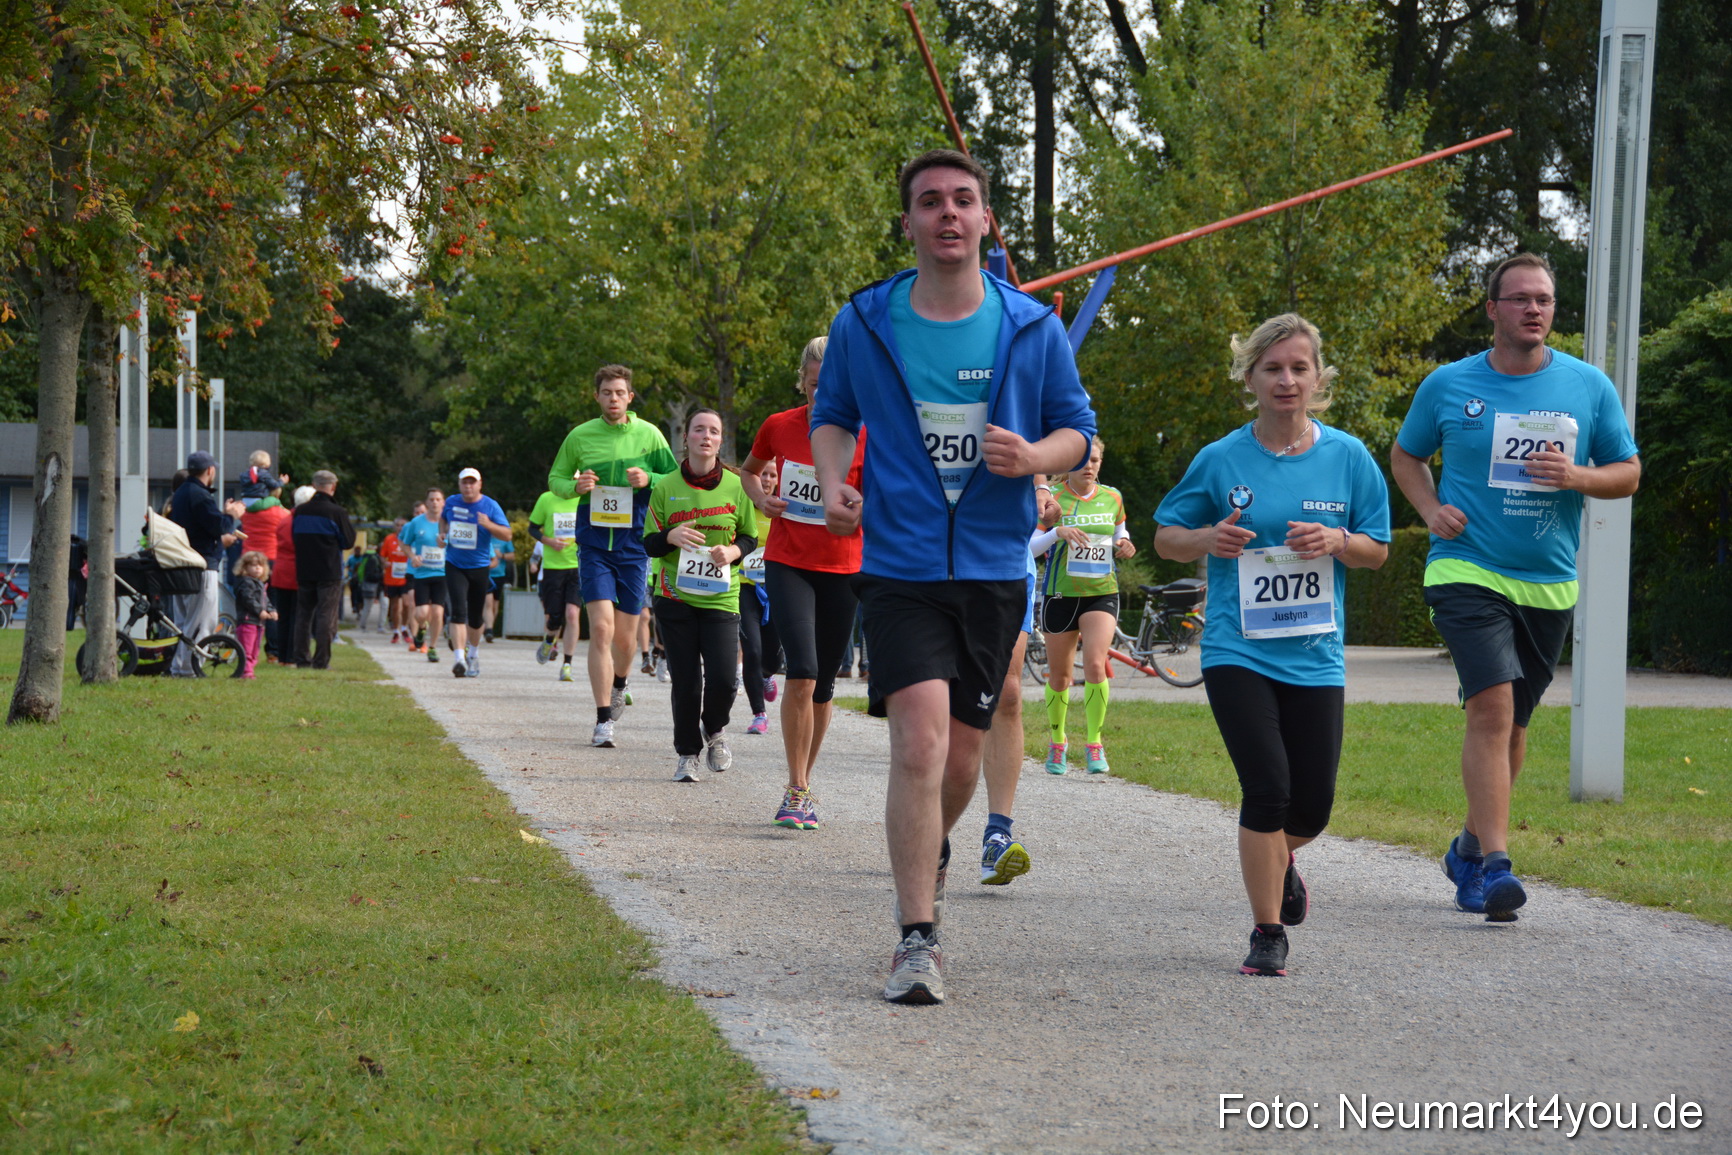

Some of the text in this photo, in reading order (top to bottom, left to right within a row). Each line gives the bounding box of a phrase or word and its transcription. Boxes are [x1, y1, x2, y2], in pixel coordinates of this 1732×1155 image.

[958, 369, 994, 380] BOC
[931, 413, 965, 422] BOCK
[922, 433, 977, 462] 250
[939, 474, 961, 483] reas
[788, 480, 821, 502] 240
[603, 498, 617, 511] 83
[1303, 500, 1345, 512] BOCK
[1503, 497, 1553, 507] Neumarkter
[801, 506, 816, 514] Julia
[1503, 507, 1544, 518] Stadtlauf
[1063, 513, 1114, 527] BOCK
[453, 529, 473, 539] 2398
[1075, 546, 1105, 561] 2782
[1273, 554, 1303, 562] BOC
[749, 558, 764, 568] 22
[685, 559, 723, 579] 2128
[1254, 571, 1321, 603] 2078
[1272, 609, 1308, 622] Justyna
